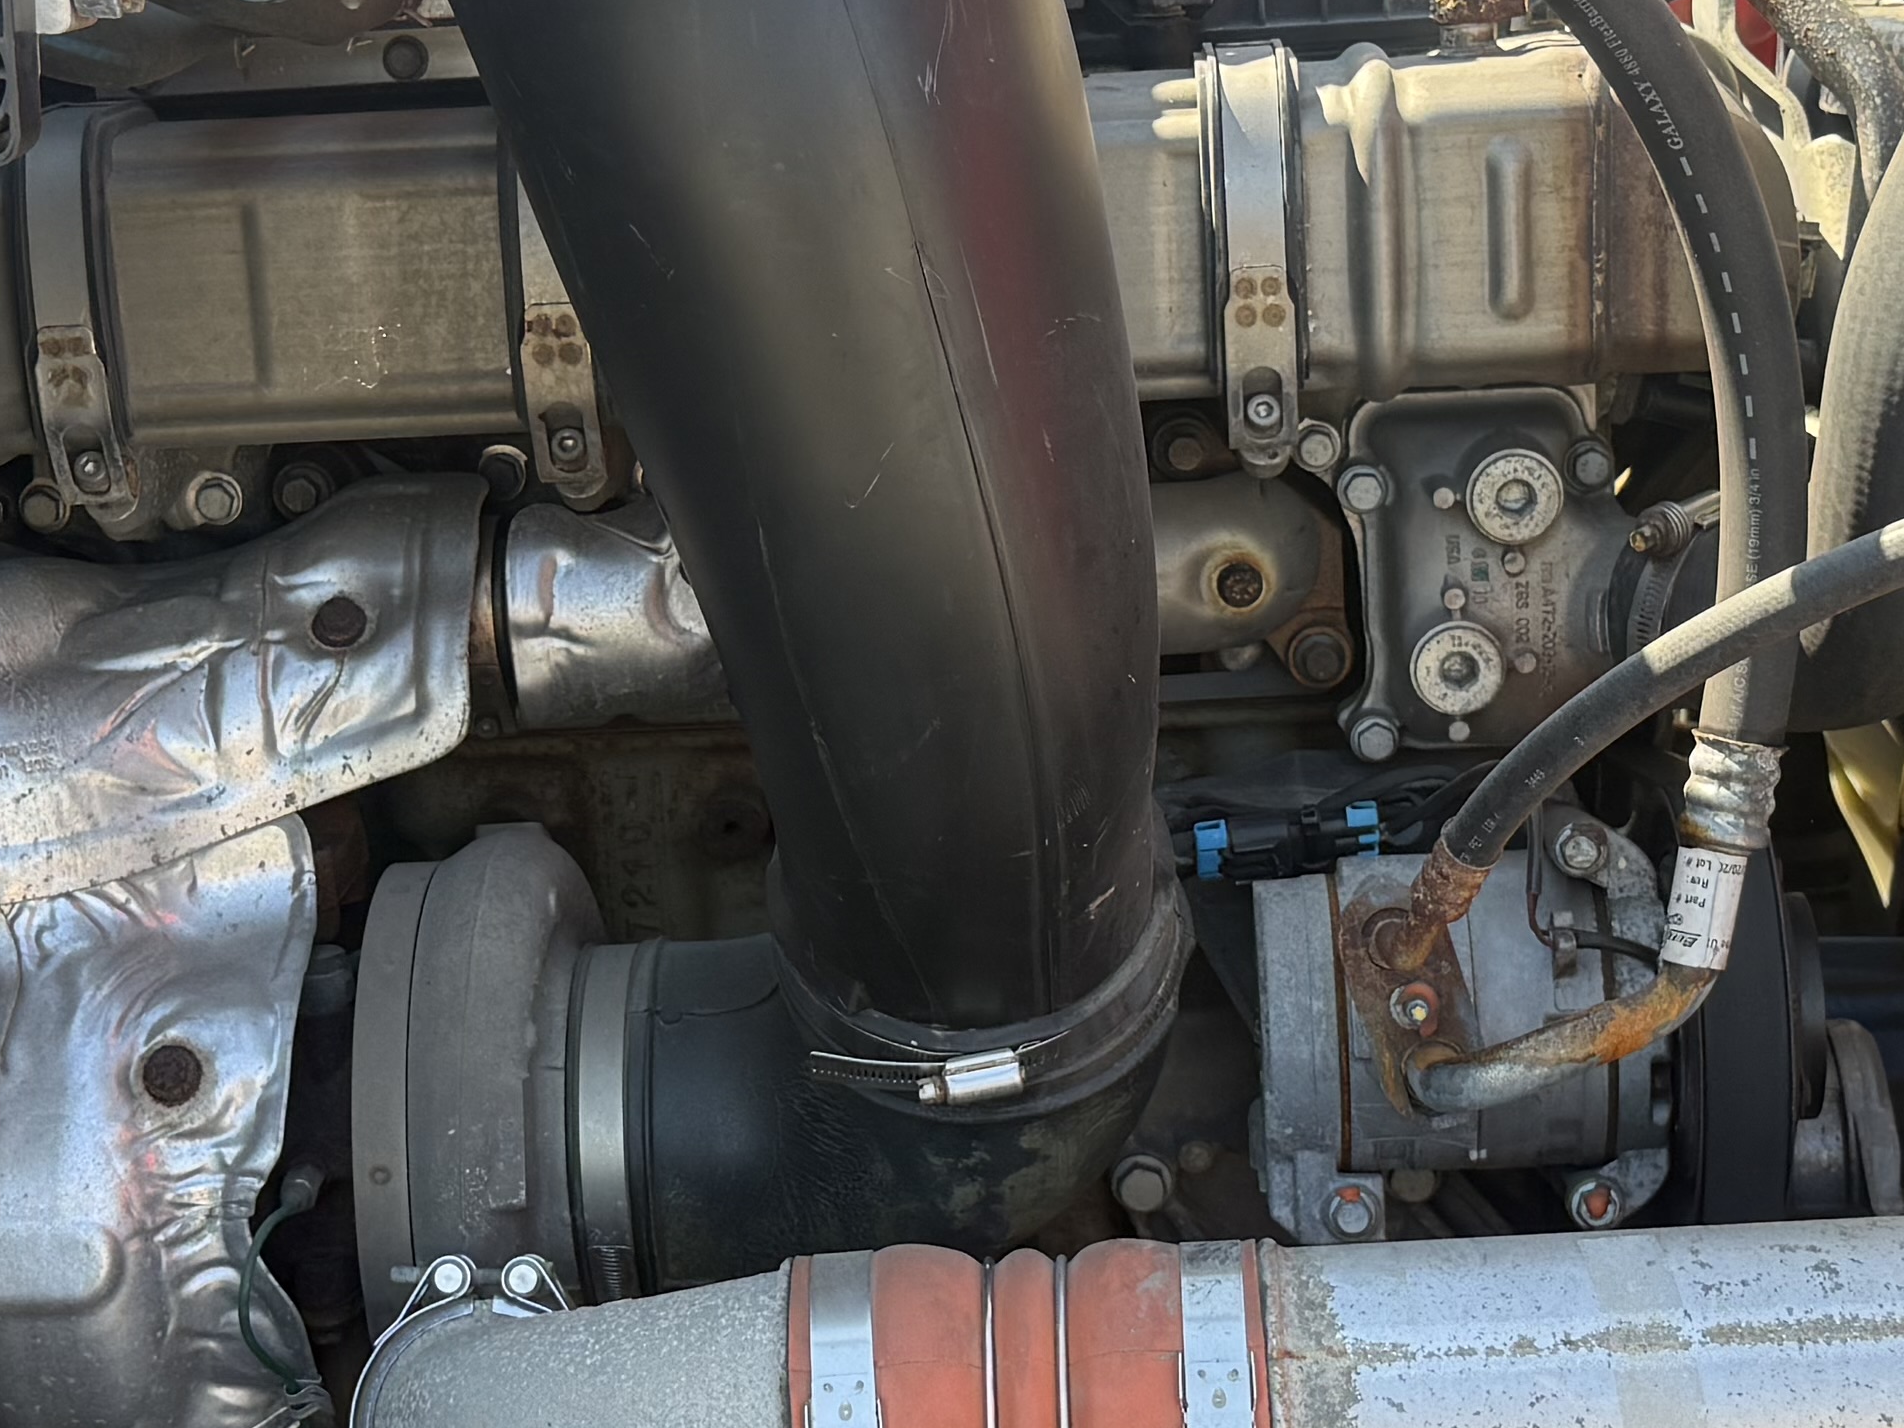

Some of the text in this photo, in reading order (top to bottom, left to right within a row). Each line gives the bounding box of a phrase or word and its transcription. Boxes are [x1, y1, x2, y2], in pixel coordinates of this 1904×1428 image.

[1614, 48, 1641, 77] 4880
[1632, 80, 1684, 151] GALAXY
[1749, 467, 1761, 481] in
[1748, 482, 1763, 505] 3/4
[1747, 509, 1763, 560] (19mm)
[1696, 858, 1712, 871] Lot
[1686, 875, 1709, 889] Rev:
[1684, 894, 1706, 909] Part
